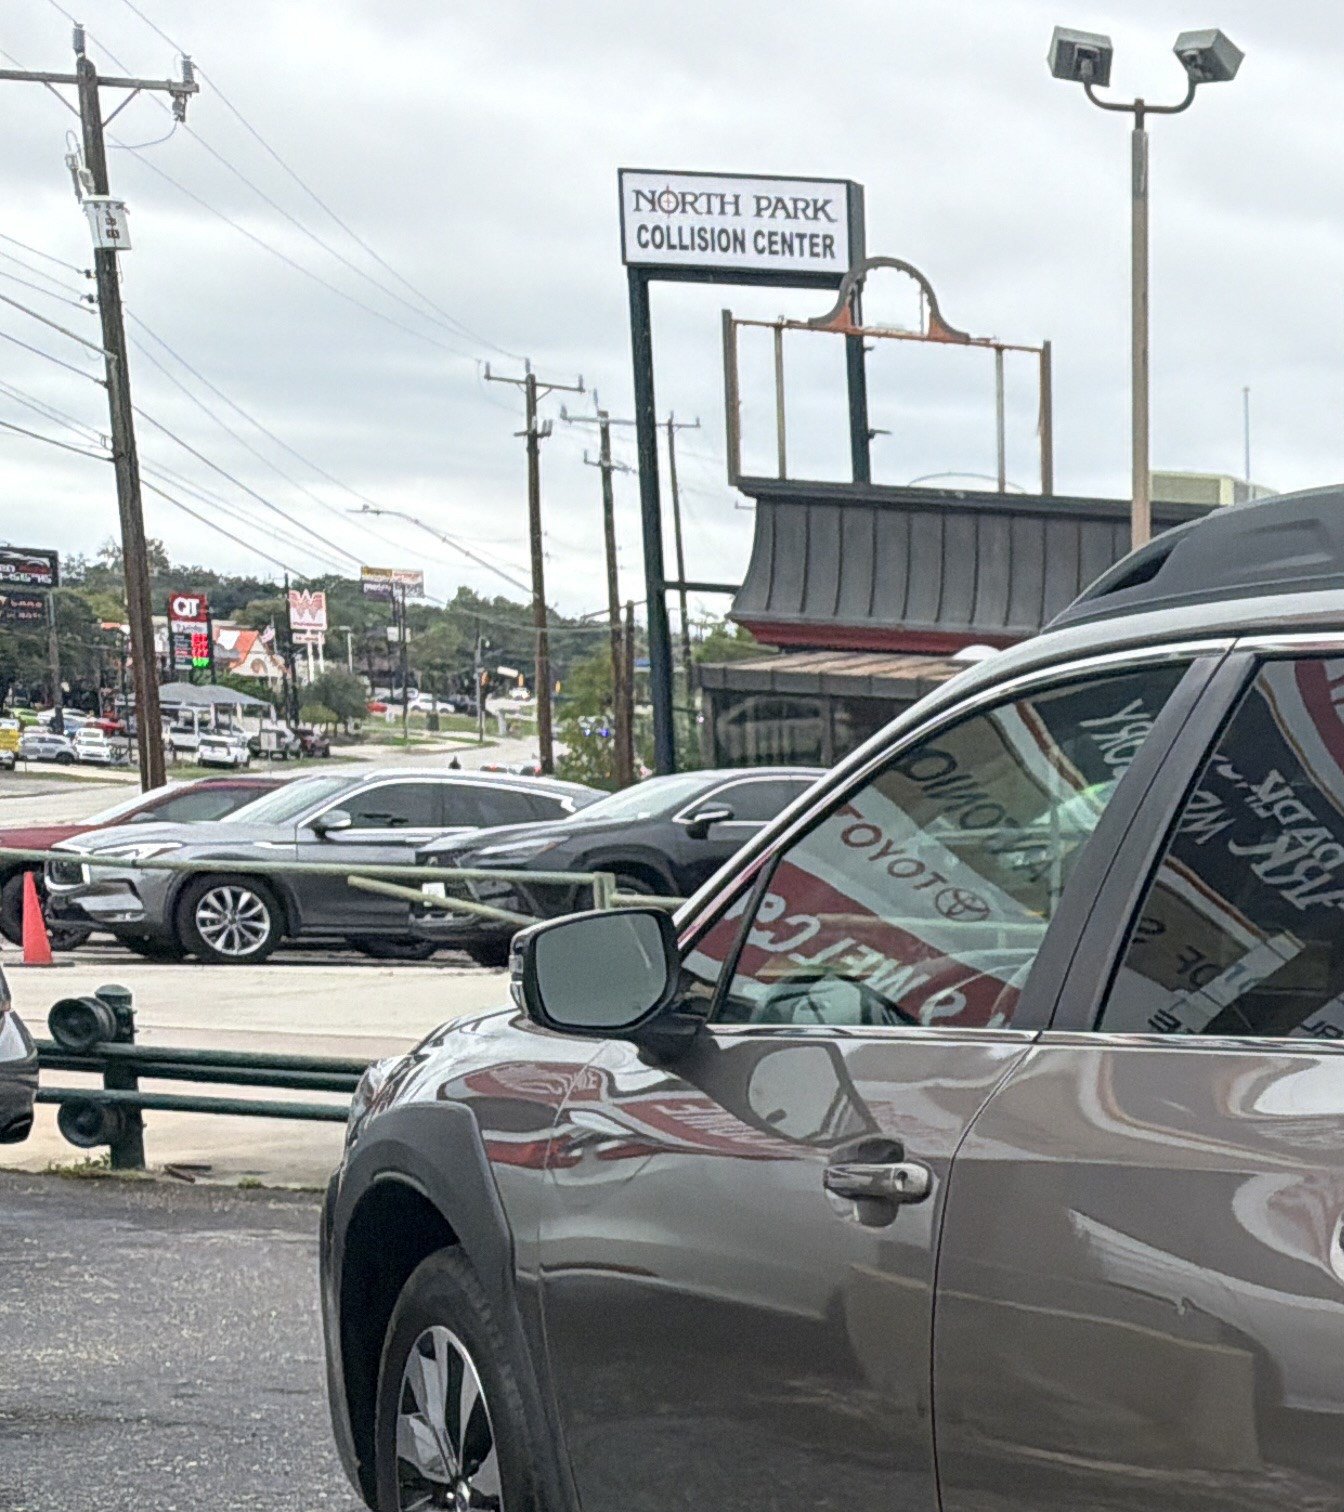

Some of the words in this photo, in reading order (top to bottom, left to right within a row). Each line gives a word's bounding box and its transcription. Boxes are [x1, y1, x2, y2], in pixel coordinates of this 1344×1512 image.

[632, 186, 741, 218] NORTH
[753, 194, 838, 222] PARK
[636, 224, 746, 254] COLLISION
[753, 230, 836, 259] CENTER
[173, 596, 200, 617] QT
